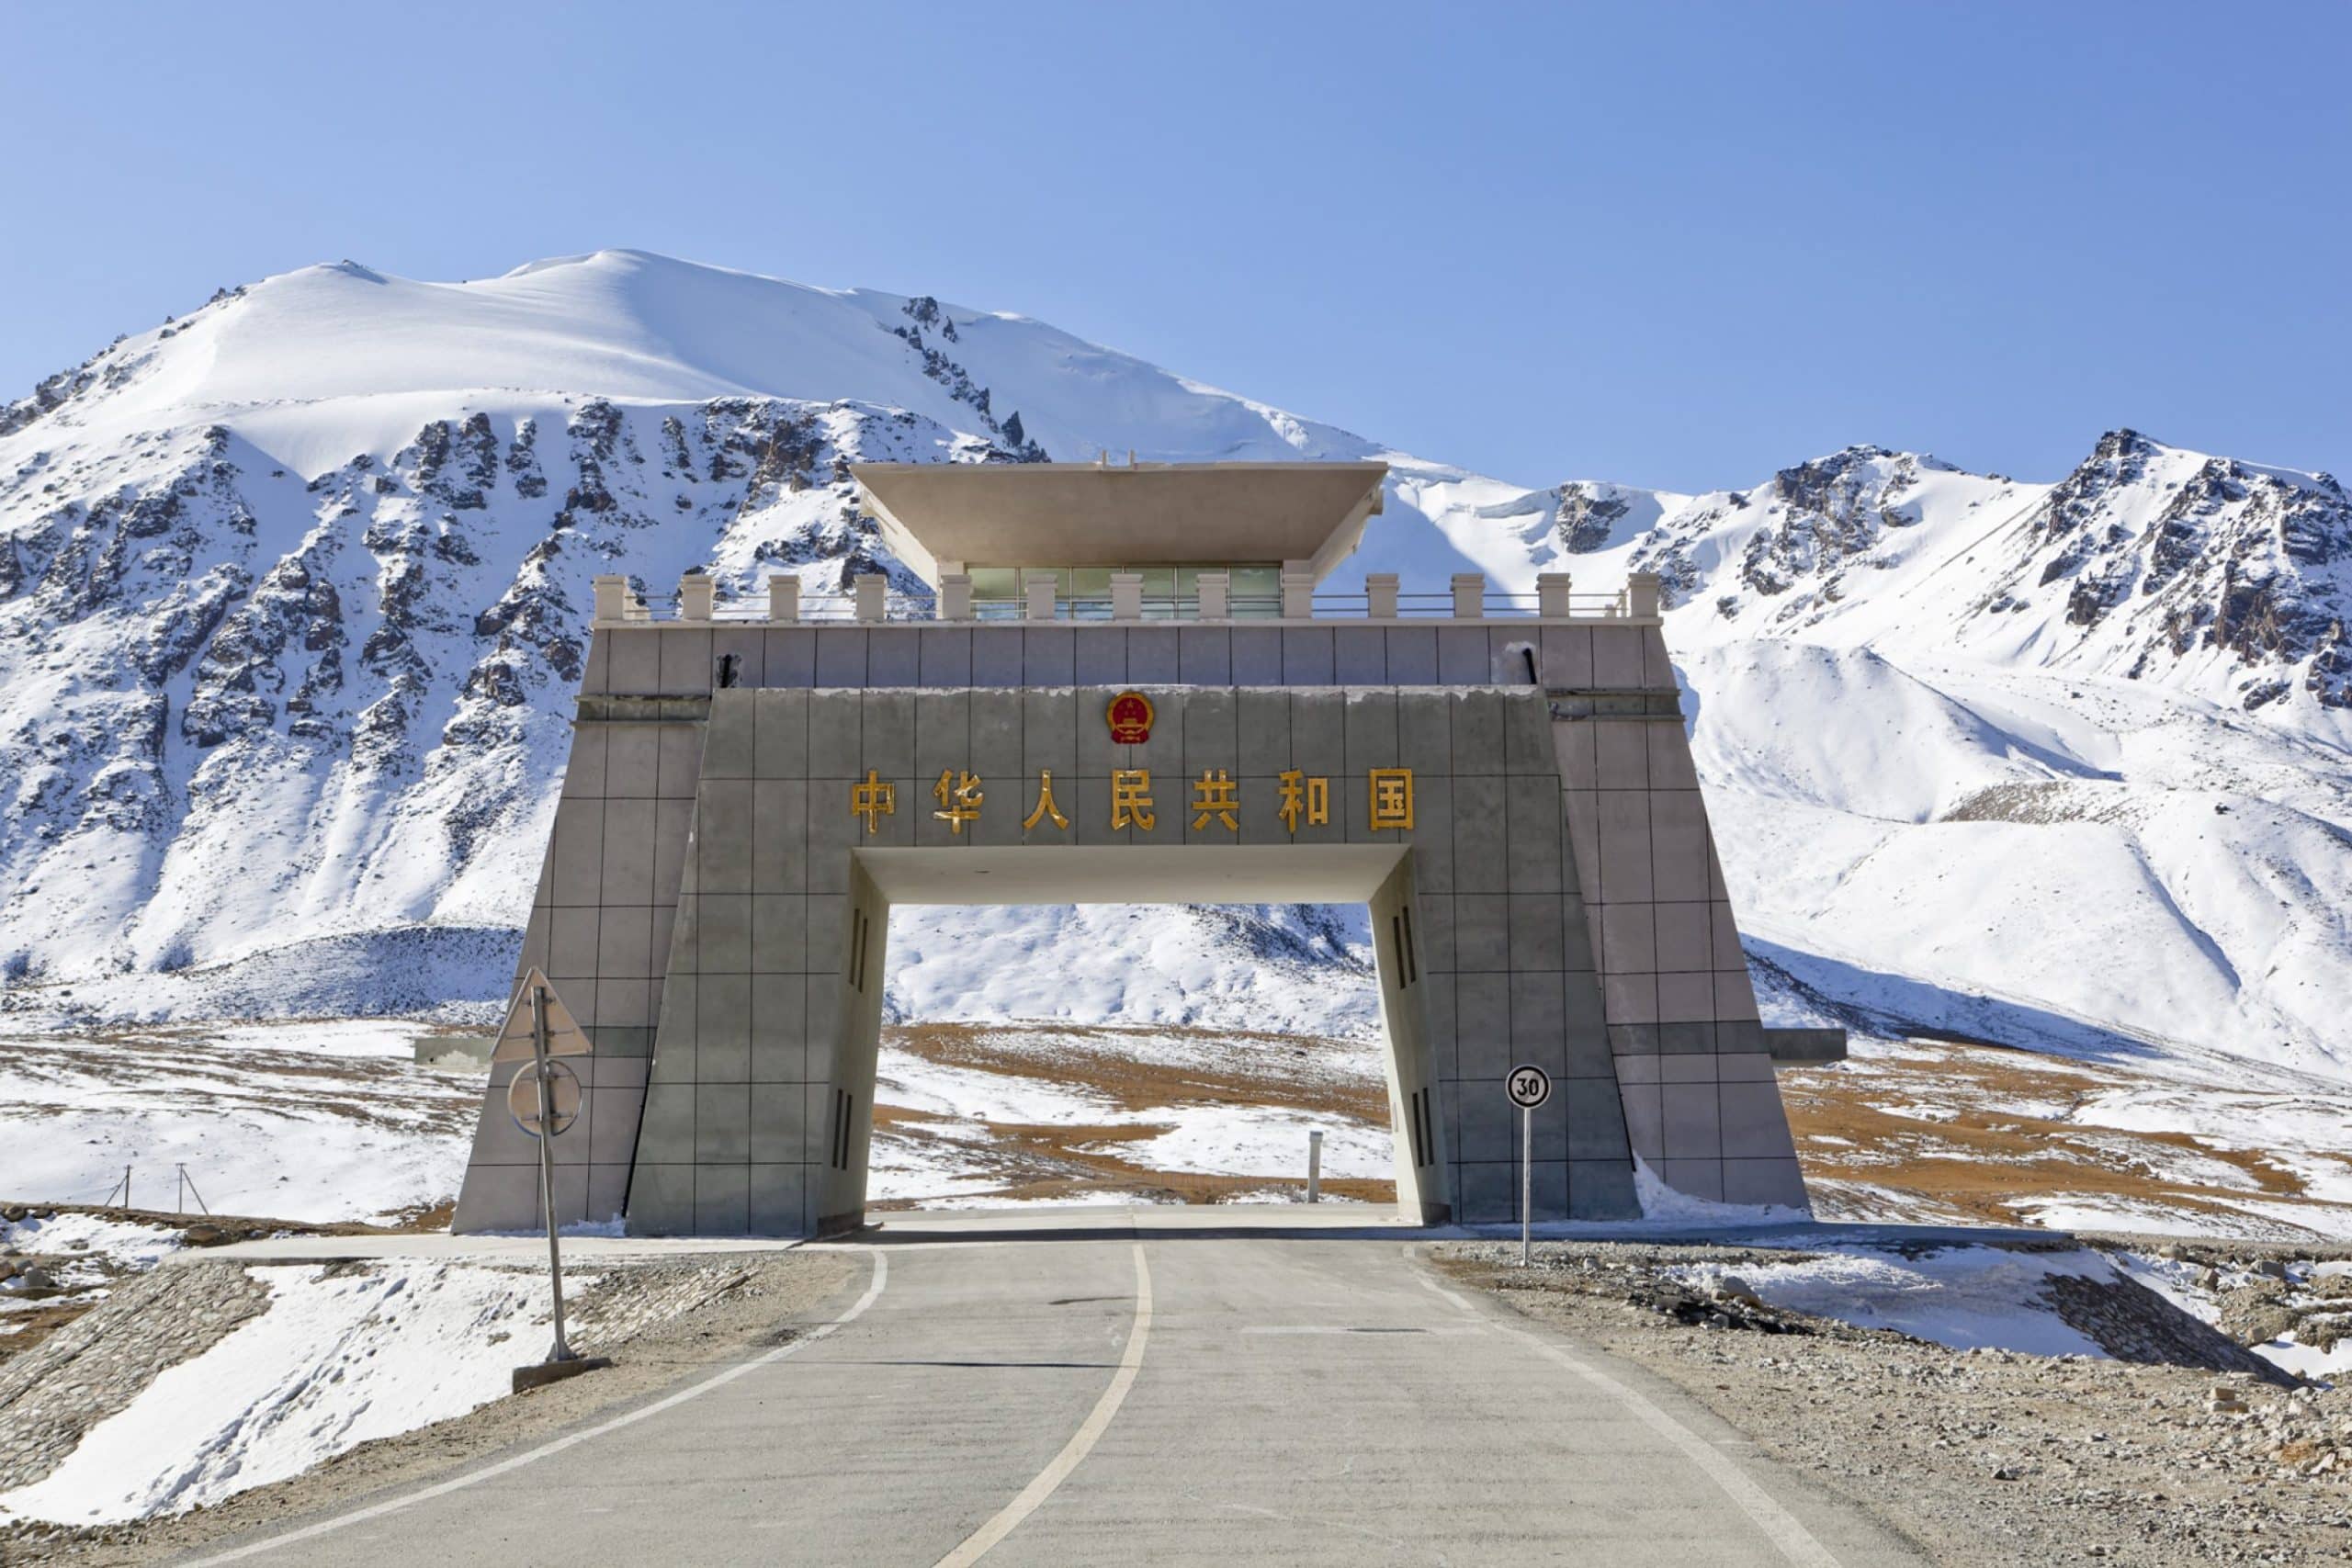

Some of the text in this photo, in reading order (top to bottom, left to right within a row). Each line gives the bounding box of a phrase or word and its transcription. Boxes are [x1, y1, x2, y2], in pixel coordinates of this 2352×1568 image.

[851, 768, 1414, 834] 中华人民共和国
[1517, 1077, 1540, 1096] 30
